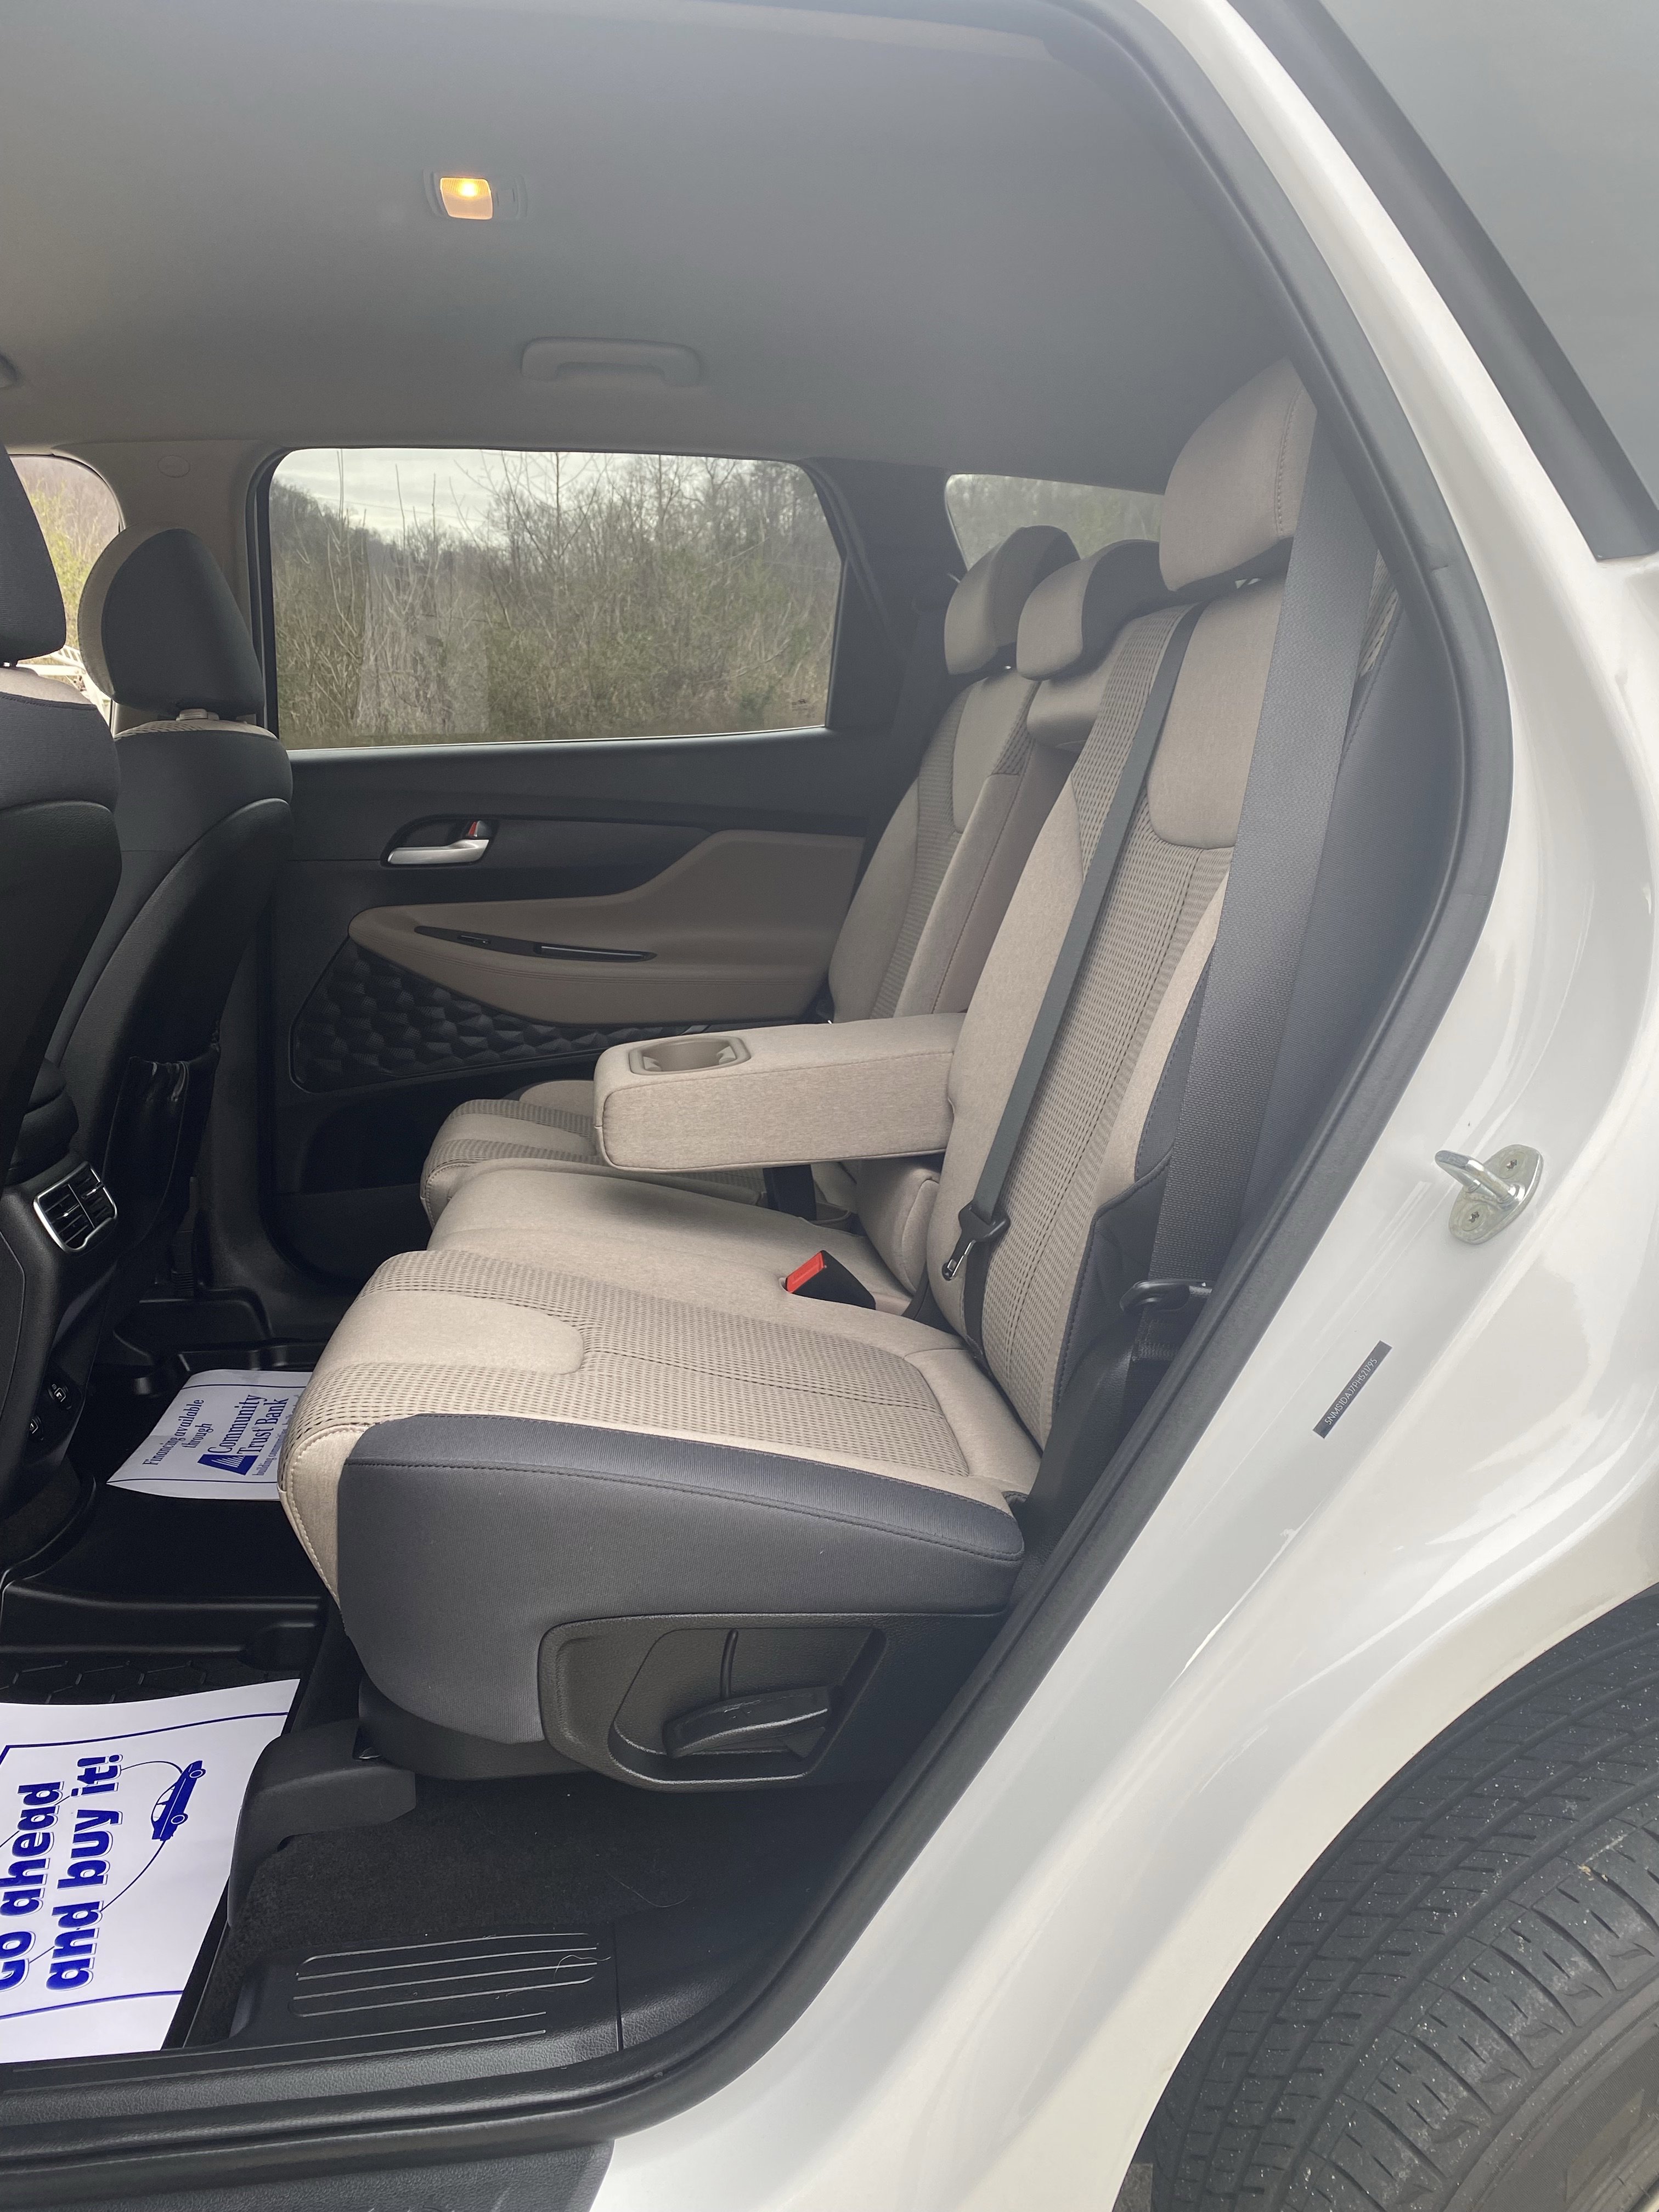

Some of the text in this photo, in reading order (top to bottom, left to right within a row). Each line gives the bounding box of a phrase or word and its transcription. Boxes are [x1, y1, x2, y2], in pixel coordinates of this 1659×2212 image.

[1324, 1358, 1378, 1425] 5NMS1DAJ7PH521795
[142, 1400, 204, 1465] Financing available
[181, 1423, 214, 1448] through
[207, 1395, 267, 1453] Community
[236, 1398, 289, 1454] Trust Bank
[252, 1458, 277, 1476] building
[0, 1780, 64, 1917] ahead
[46, 1753, 123, 1990] and buy it!
